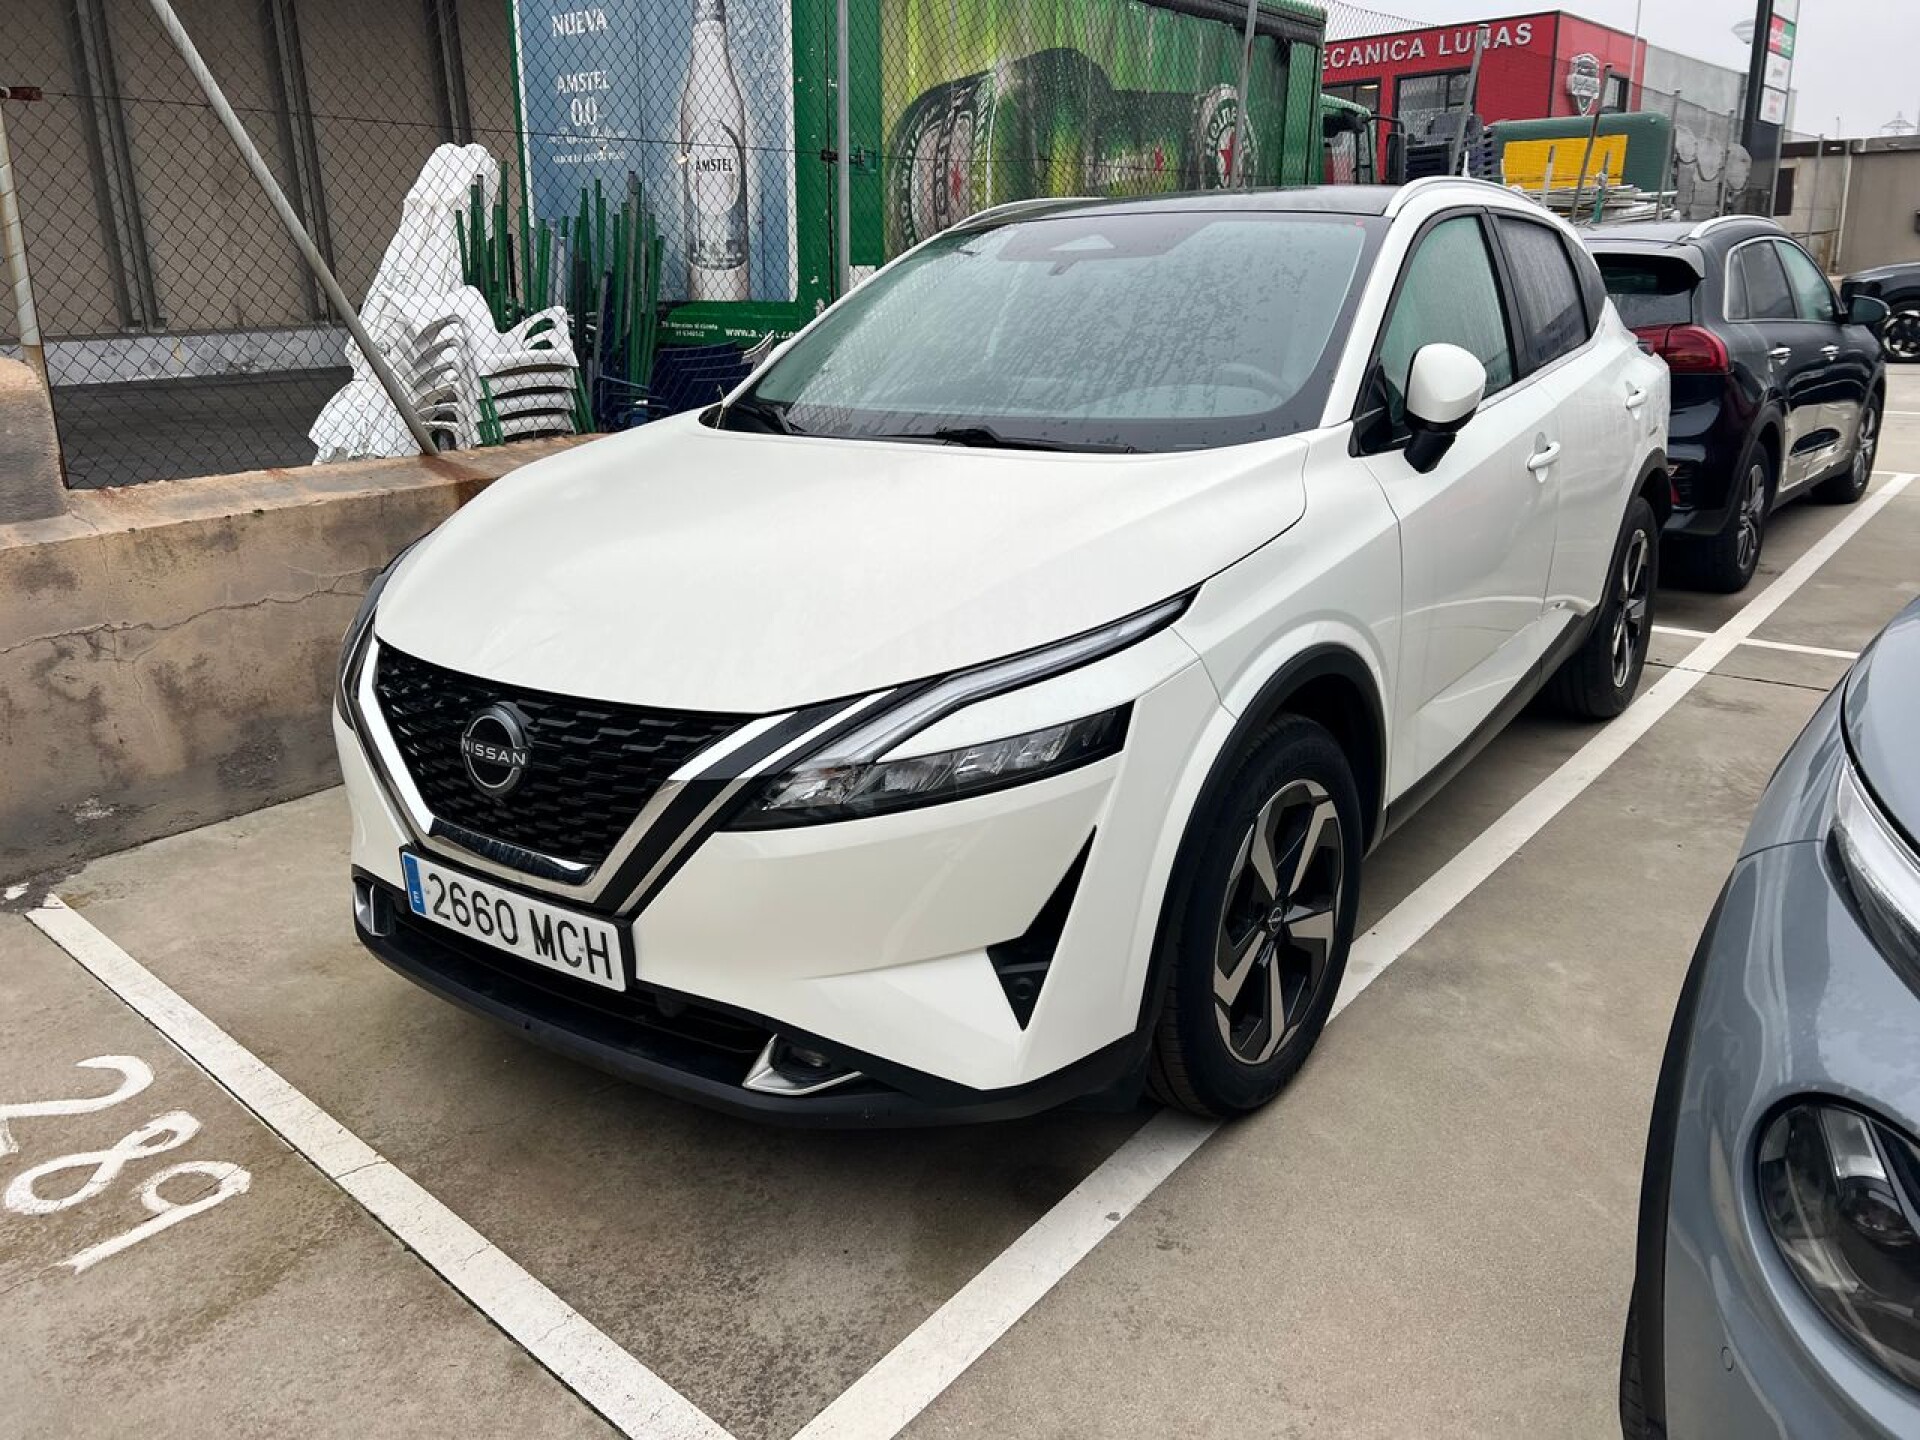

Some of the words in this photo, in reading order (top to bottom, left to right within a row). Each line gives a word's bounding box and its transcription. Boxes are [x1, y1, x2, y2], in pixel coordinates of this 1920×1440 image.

[552, 8, 608, 36] NUEVA
[557, 70, 610, 93] AMSTEL
[696, 158, 733, 172] AMSTEL
[461, 732, 526, 766] NISSAN
[428, 872, 518, 946] 2660
[528, 908, 613, 981] MCH
[0, 1055, 251, 1275] 289
